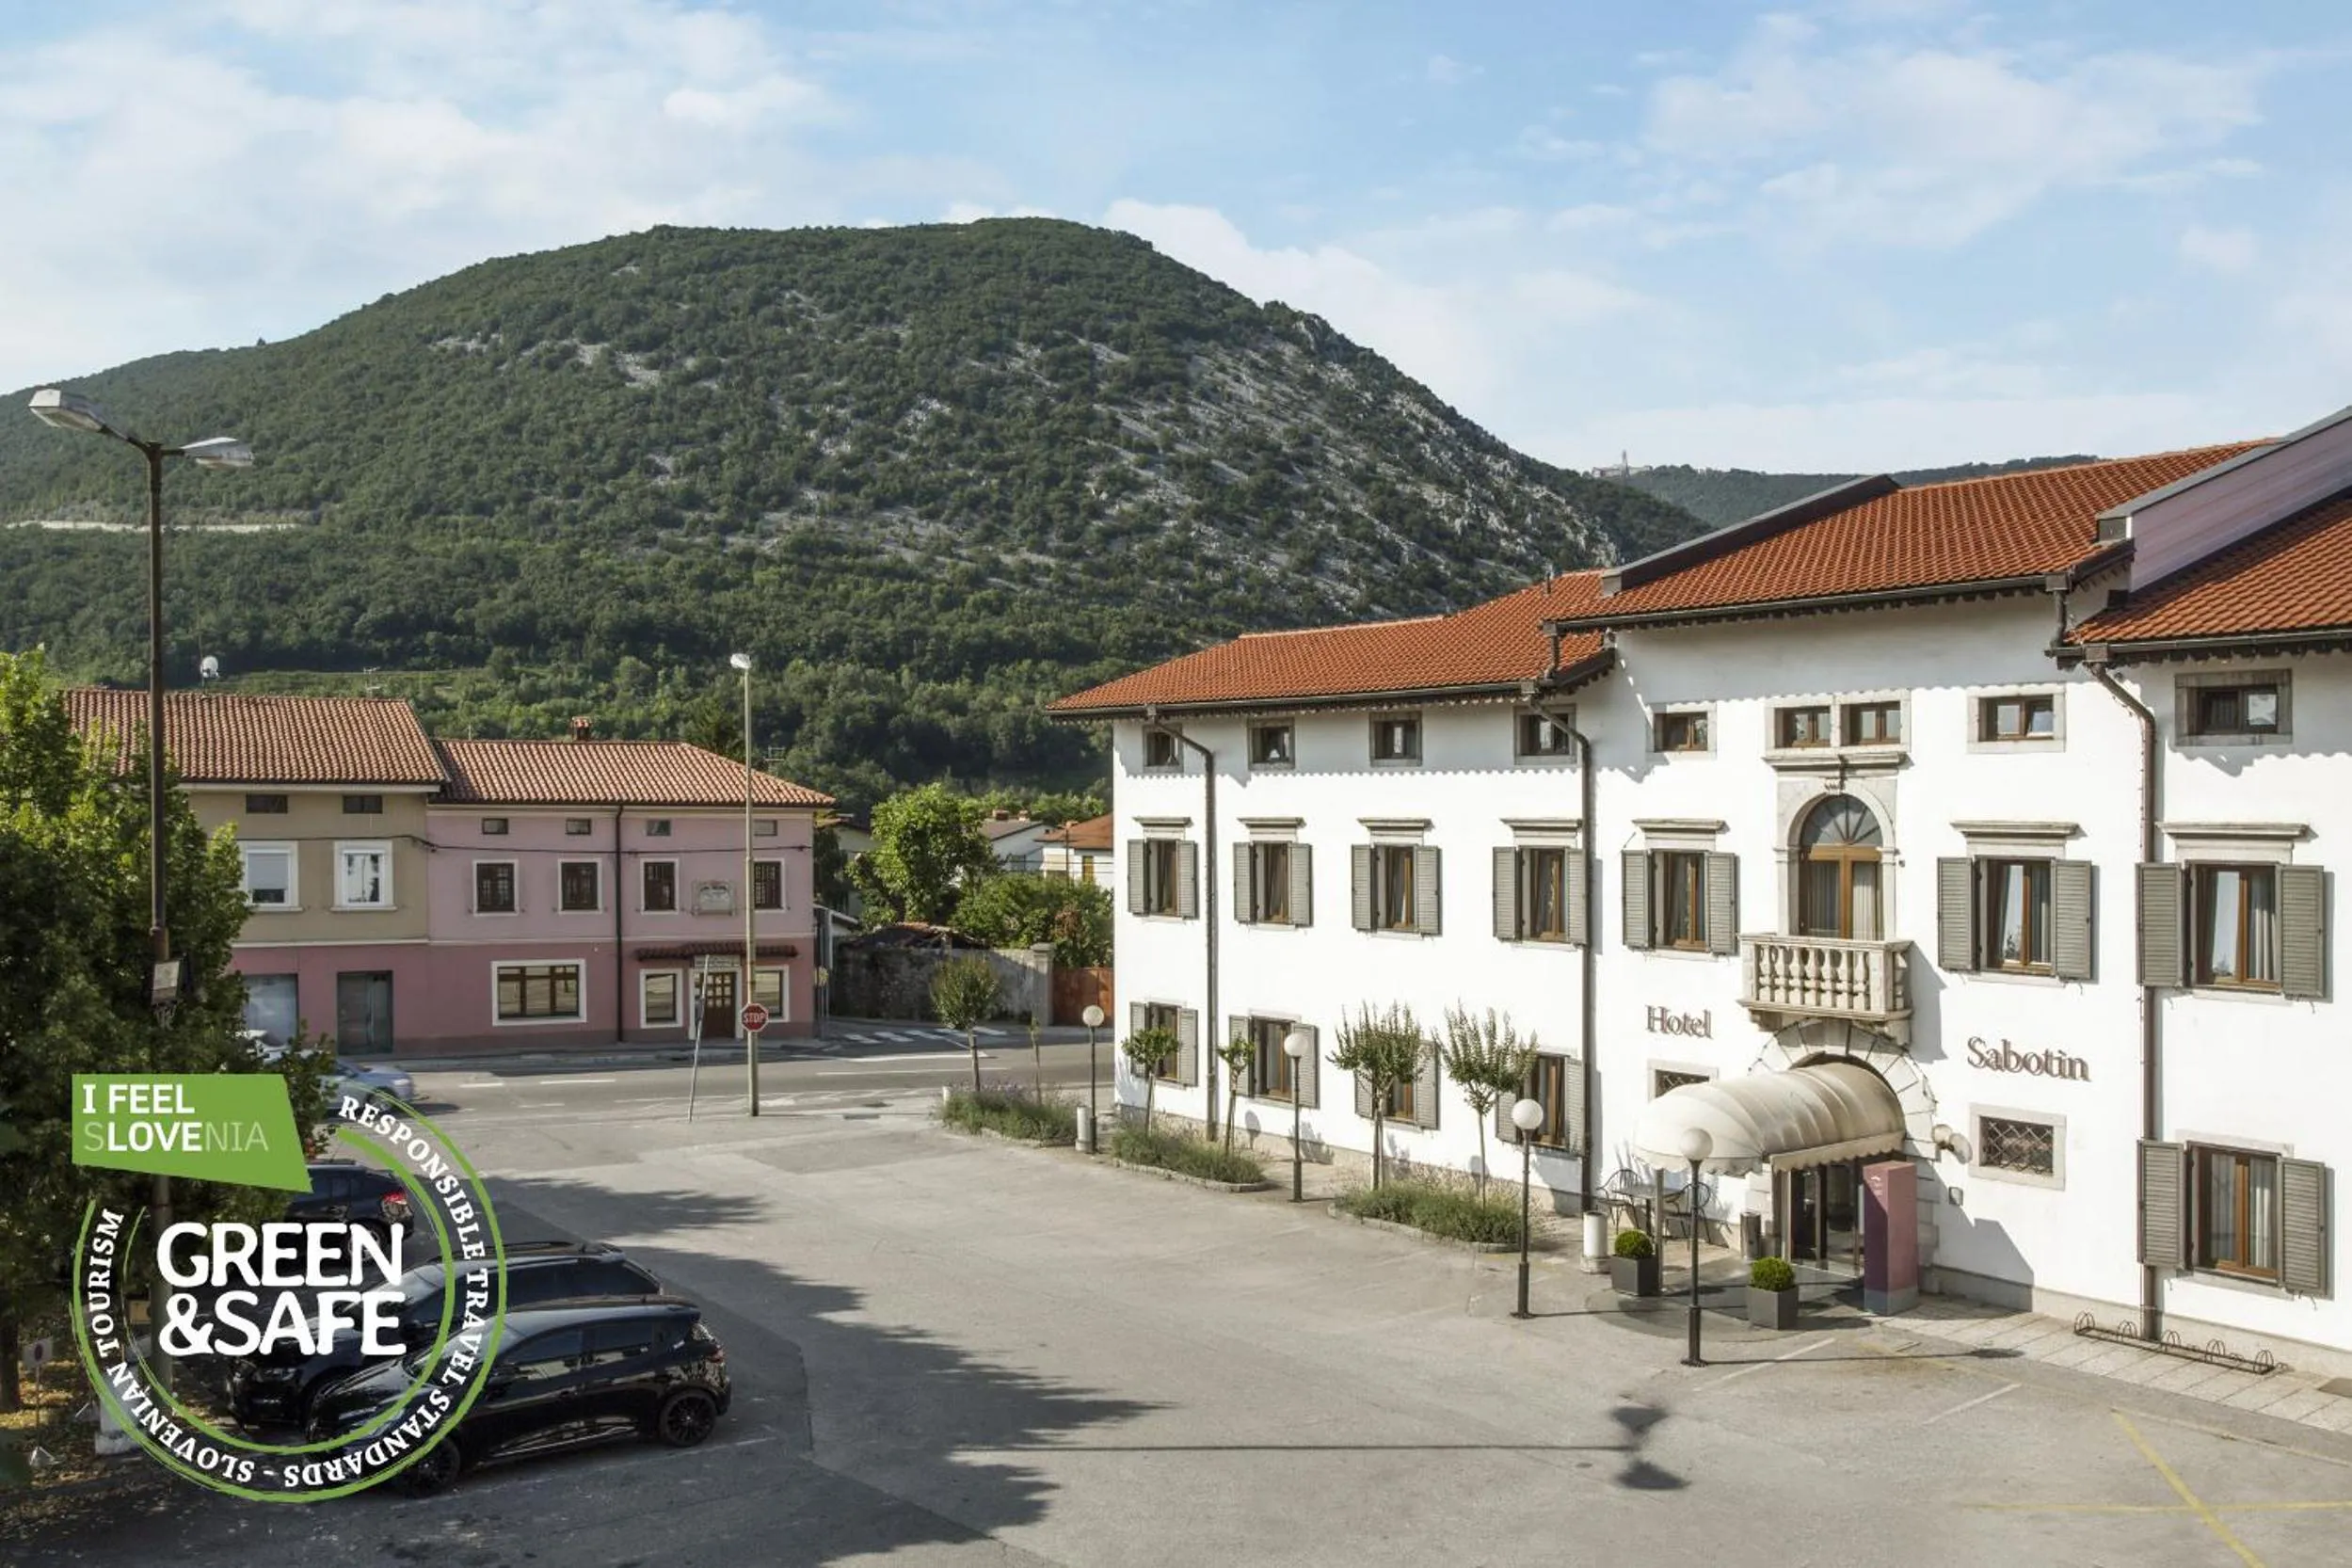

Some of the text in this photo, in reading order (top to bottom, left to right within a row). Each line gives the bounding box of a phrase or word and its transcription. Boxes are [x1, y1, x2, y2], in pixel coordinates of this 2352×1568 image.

[743, 1012, 767, 1026] STOP
[1644, 1003, 1714, 1040] Hotel
[1967, 1035, 2091, 1082] Sabotin
